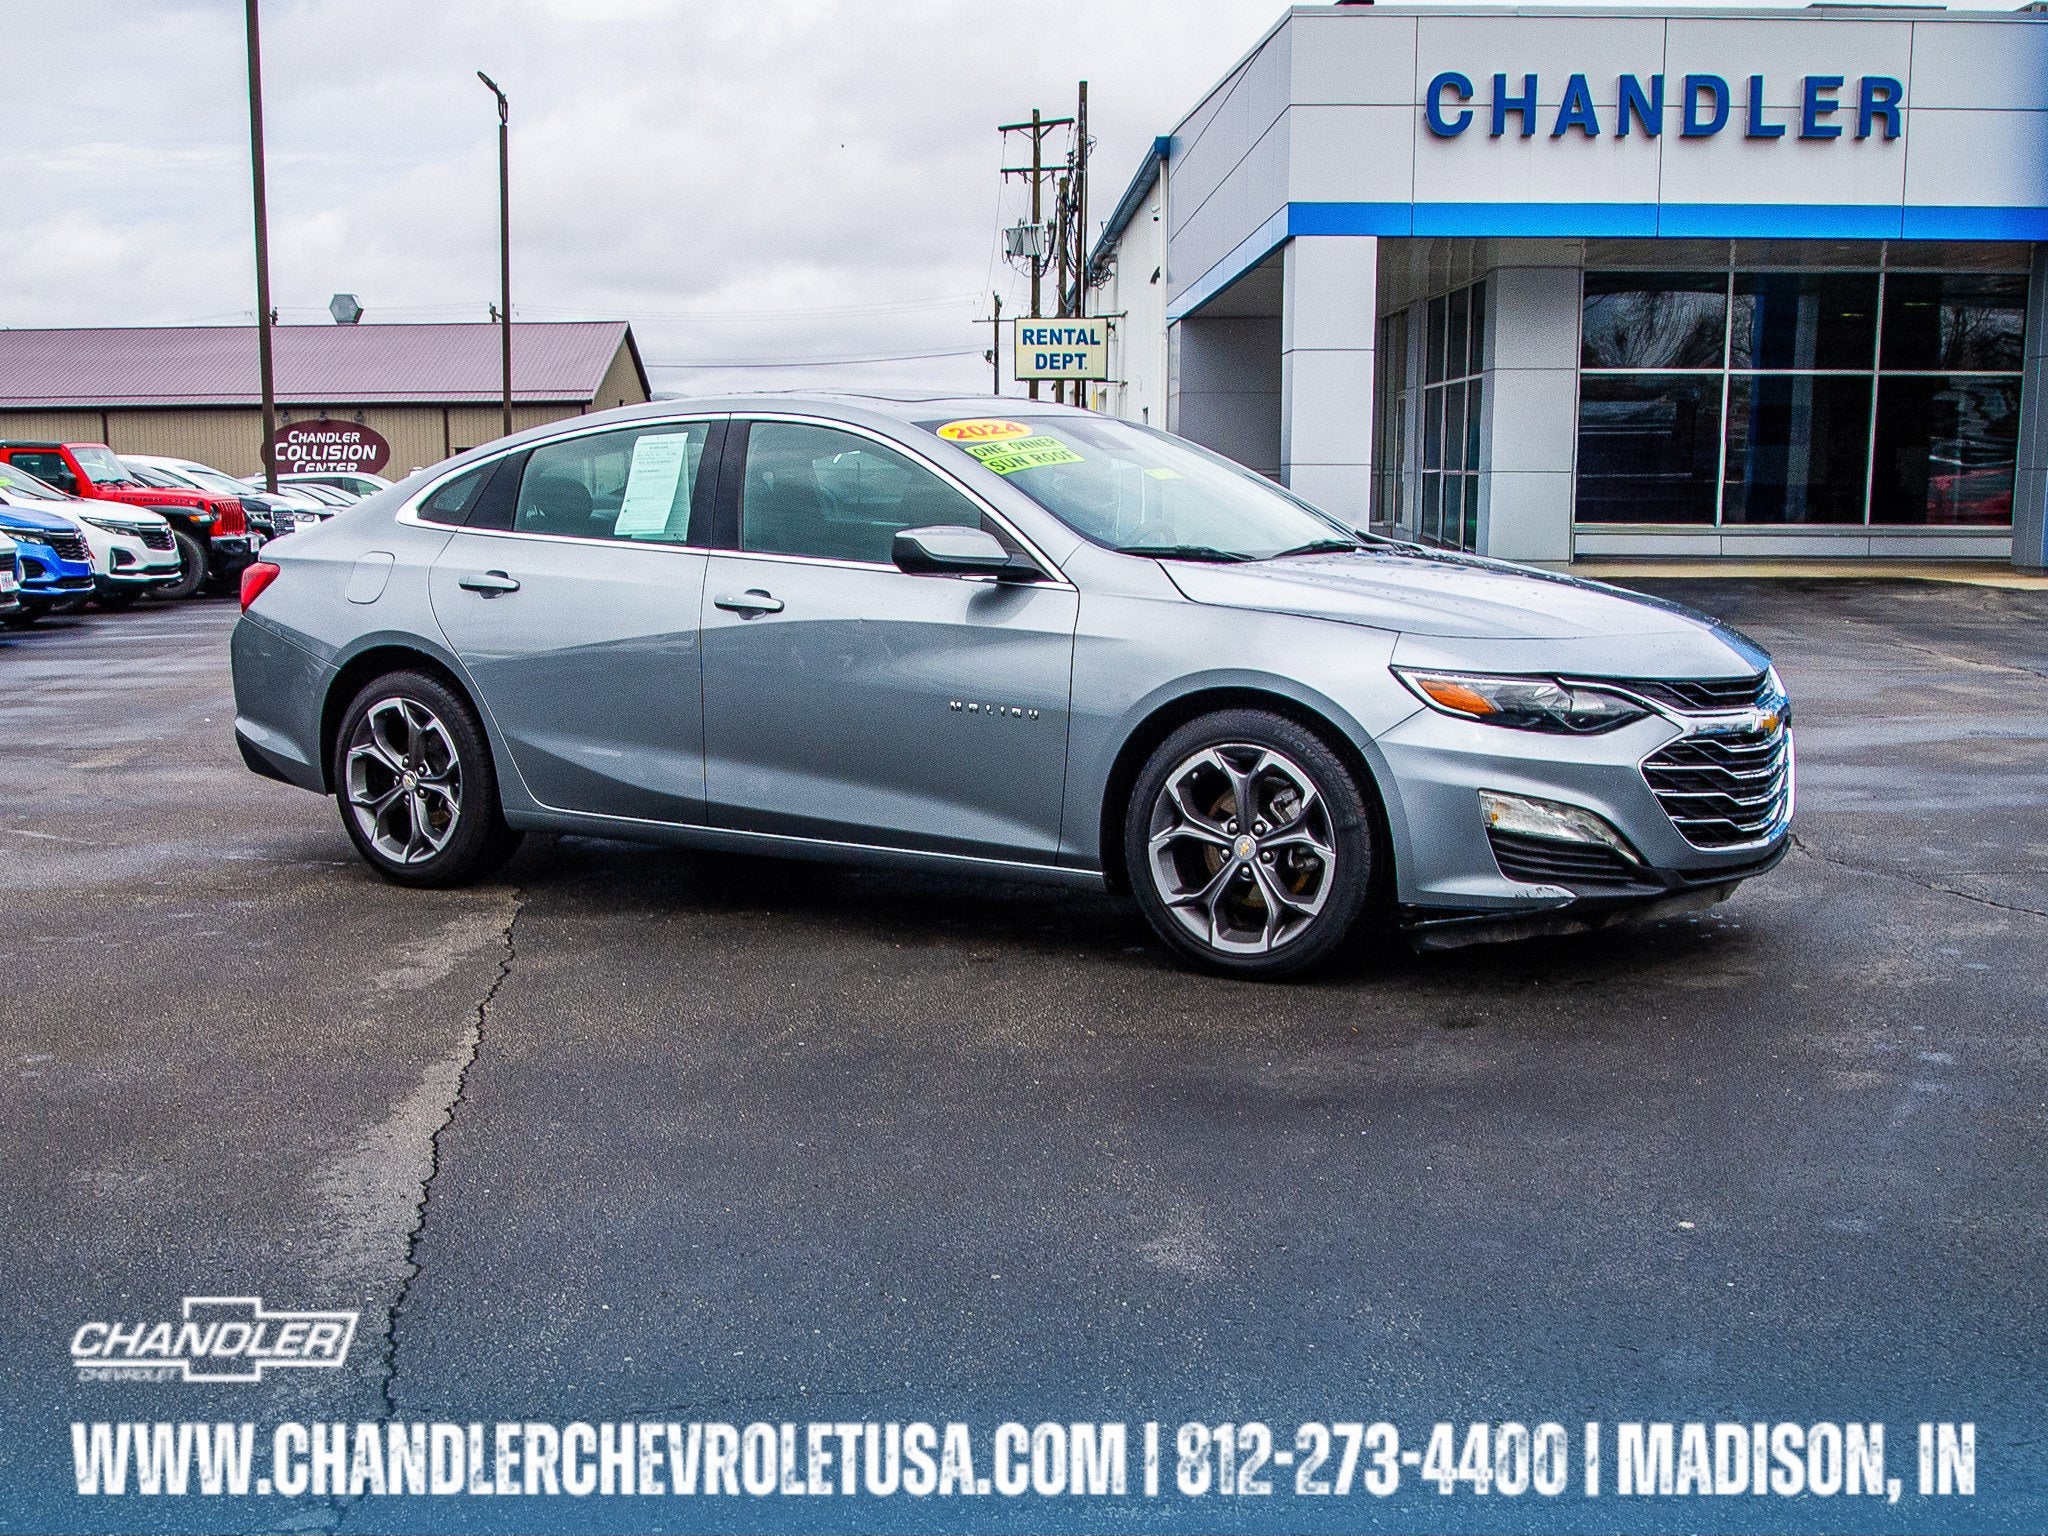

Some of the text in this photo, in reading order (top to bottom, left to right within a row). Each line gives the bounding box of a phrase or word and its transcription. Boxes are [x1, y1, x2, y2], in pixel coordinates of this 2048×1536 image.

[1424, 71, 1905, 139] CHANDLER
[1022, 328, 1101, 345] RENTAL
[1035, 353, 1088, 370] DEPT.
[288, 431, 361, 443] CHANDLER
[949, 423, 1025, 439] 2024
[275, 442, 377, 460] COLLISION
[973, 437, 1061, 457] ONE OWNER
[293, 460, 359, 473] CENTER
[989, 449, 1076, 472] SUN ROOF
